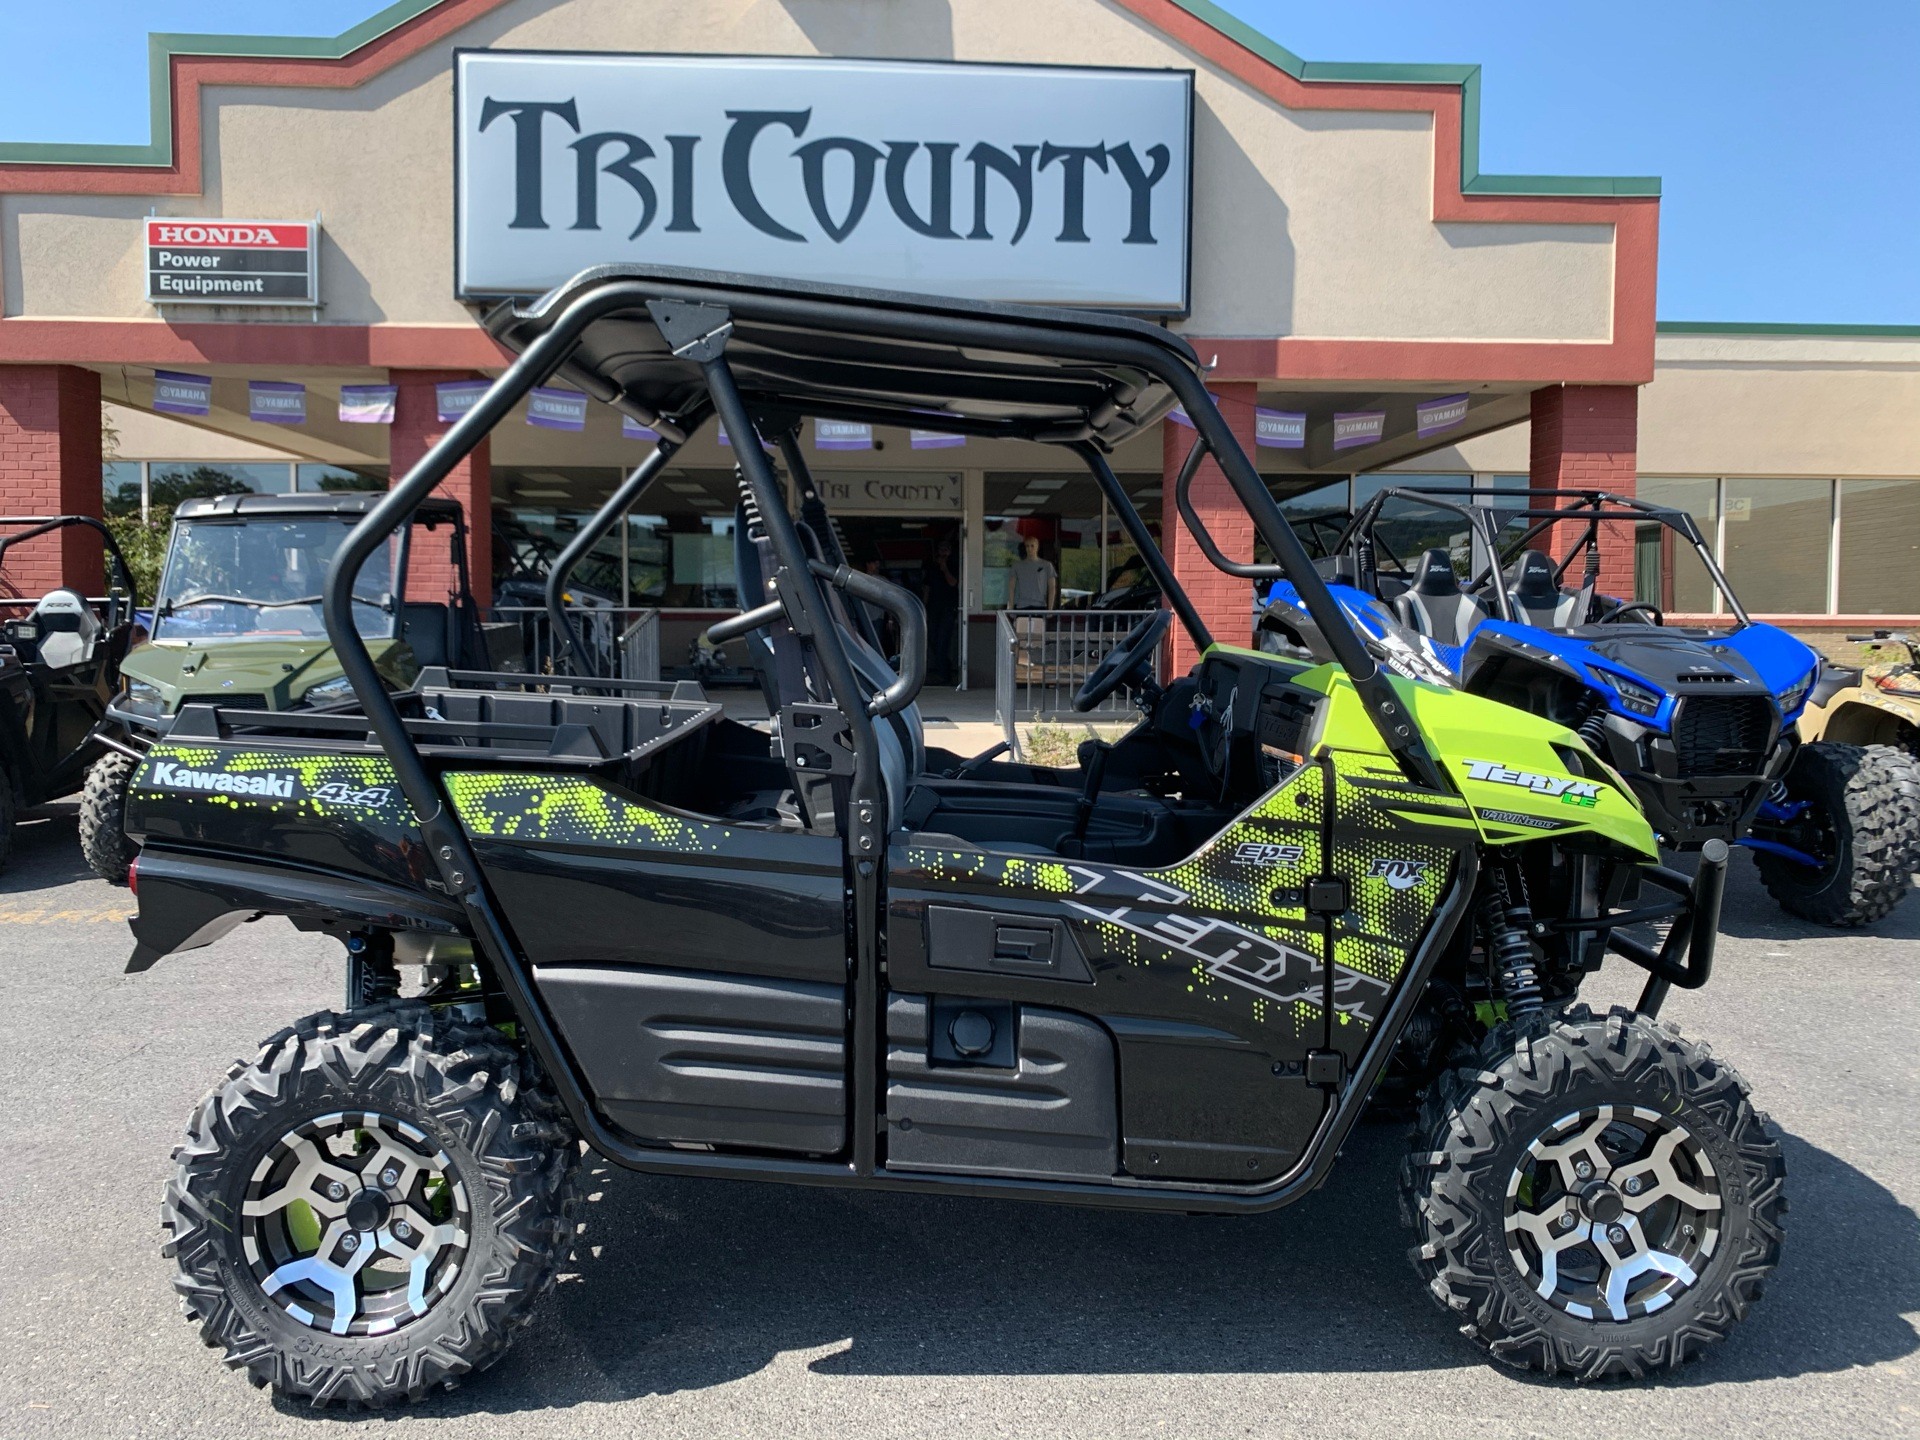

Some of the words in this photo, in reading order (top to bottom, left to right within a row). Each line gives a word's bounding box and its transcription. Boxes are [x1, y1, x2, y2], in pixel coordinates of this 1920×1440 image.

[478, 95, 702, 242] TRI
[722, 106, 1172, 246] COUNTY
[157, 226, 279, 244] HONDA
[158, 251, 221, 268] Power
[159, 274, 264, 294] Equipment
[170, 386, 206, 401] YAMAHA
[265, 397, 300, 409] YAMAHA
[544, 402, 580, 416] YAMAHA
[1433, 406, 1467, 422] YAMAHA
[831, 425, 866, 435] YAMAHA
[1268, 423, 1301, 434] YAMAHA
[1346, 421, 1378, 433] YAMAHA
[864, 480, 944, 500] COUNTY
[1387, 656, 1416, 681] 1000
[152, 761, 295, 798] Kawasaki
[312, 782, 392, 807] 4x4
[1462, 758, 1607, 800] TERYX
[1561, 792, 1601, 809] LE
[1234, 842, 1304, 862] EPS
[1366, 858, 1428, 881] FOX
